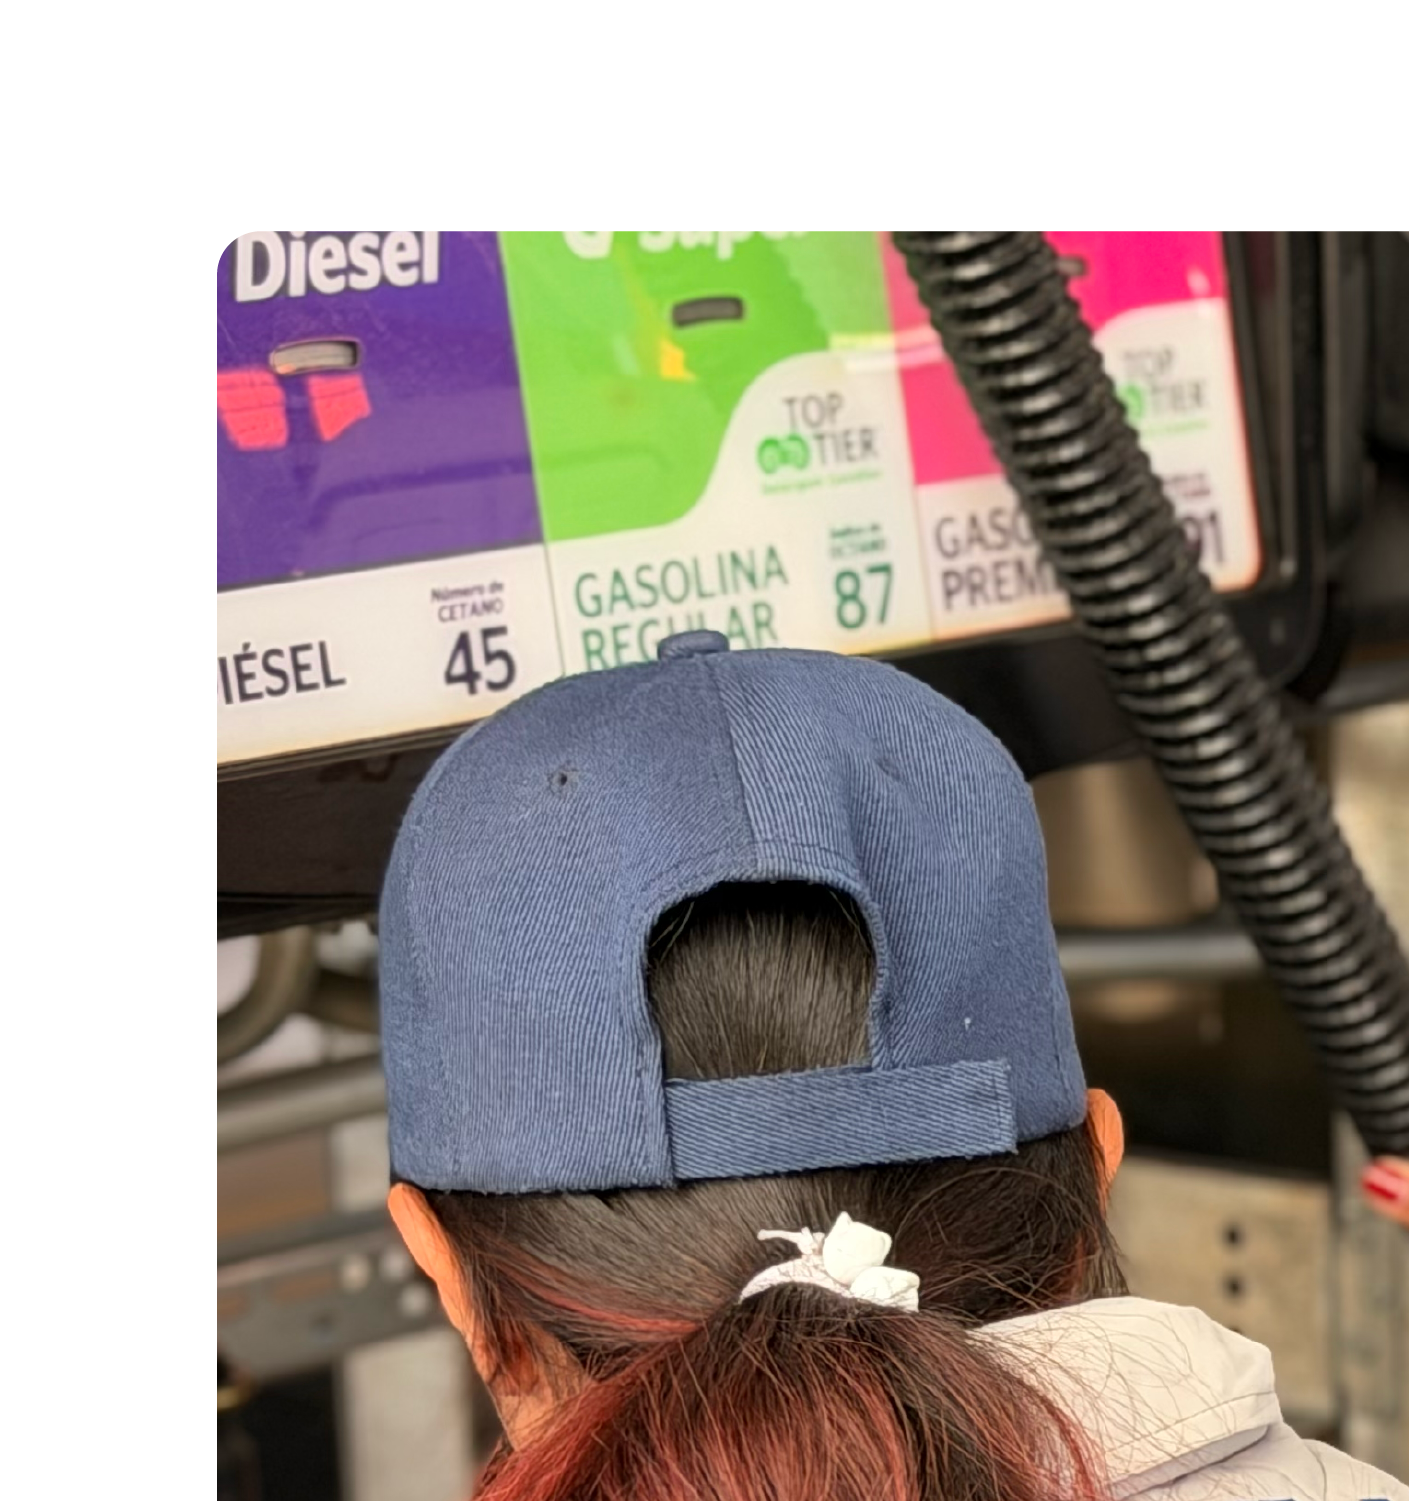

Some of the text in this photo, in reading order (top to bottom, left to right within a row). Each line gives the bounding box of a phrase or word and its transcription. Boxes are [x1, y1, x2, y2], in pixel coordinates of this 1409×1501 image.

[235, 231, 441, 302] Diesel
[783, 391, 845, 432] TOP
[813, 428, 879, 465] TIER
[437, 597, 505, 623] CETANO
[574, 545, 789, 618] GASOLINA
[834, 562, 894, 629] 87
[443, 624, 518, 695] 45
[581, 602, 778, 673] REGAR
[217, 639, 348, 706] IÉSEL
